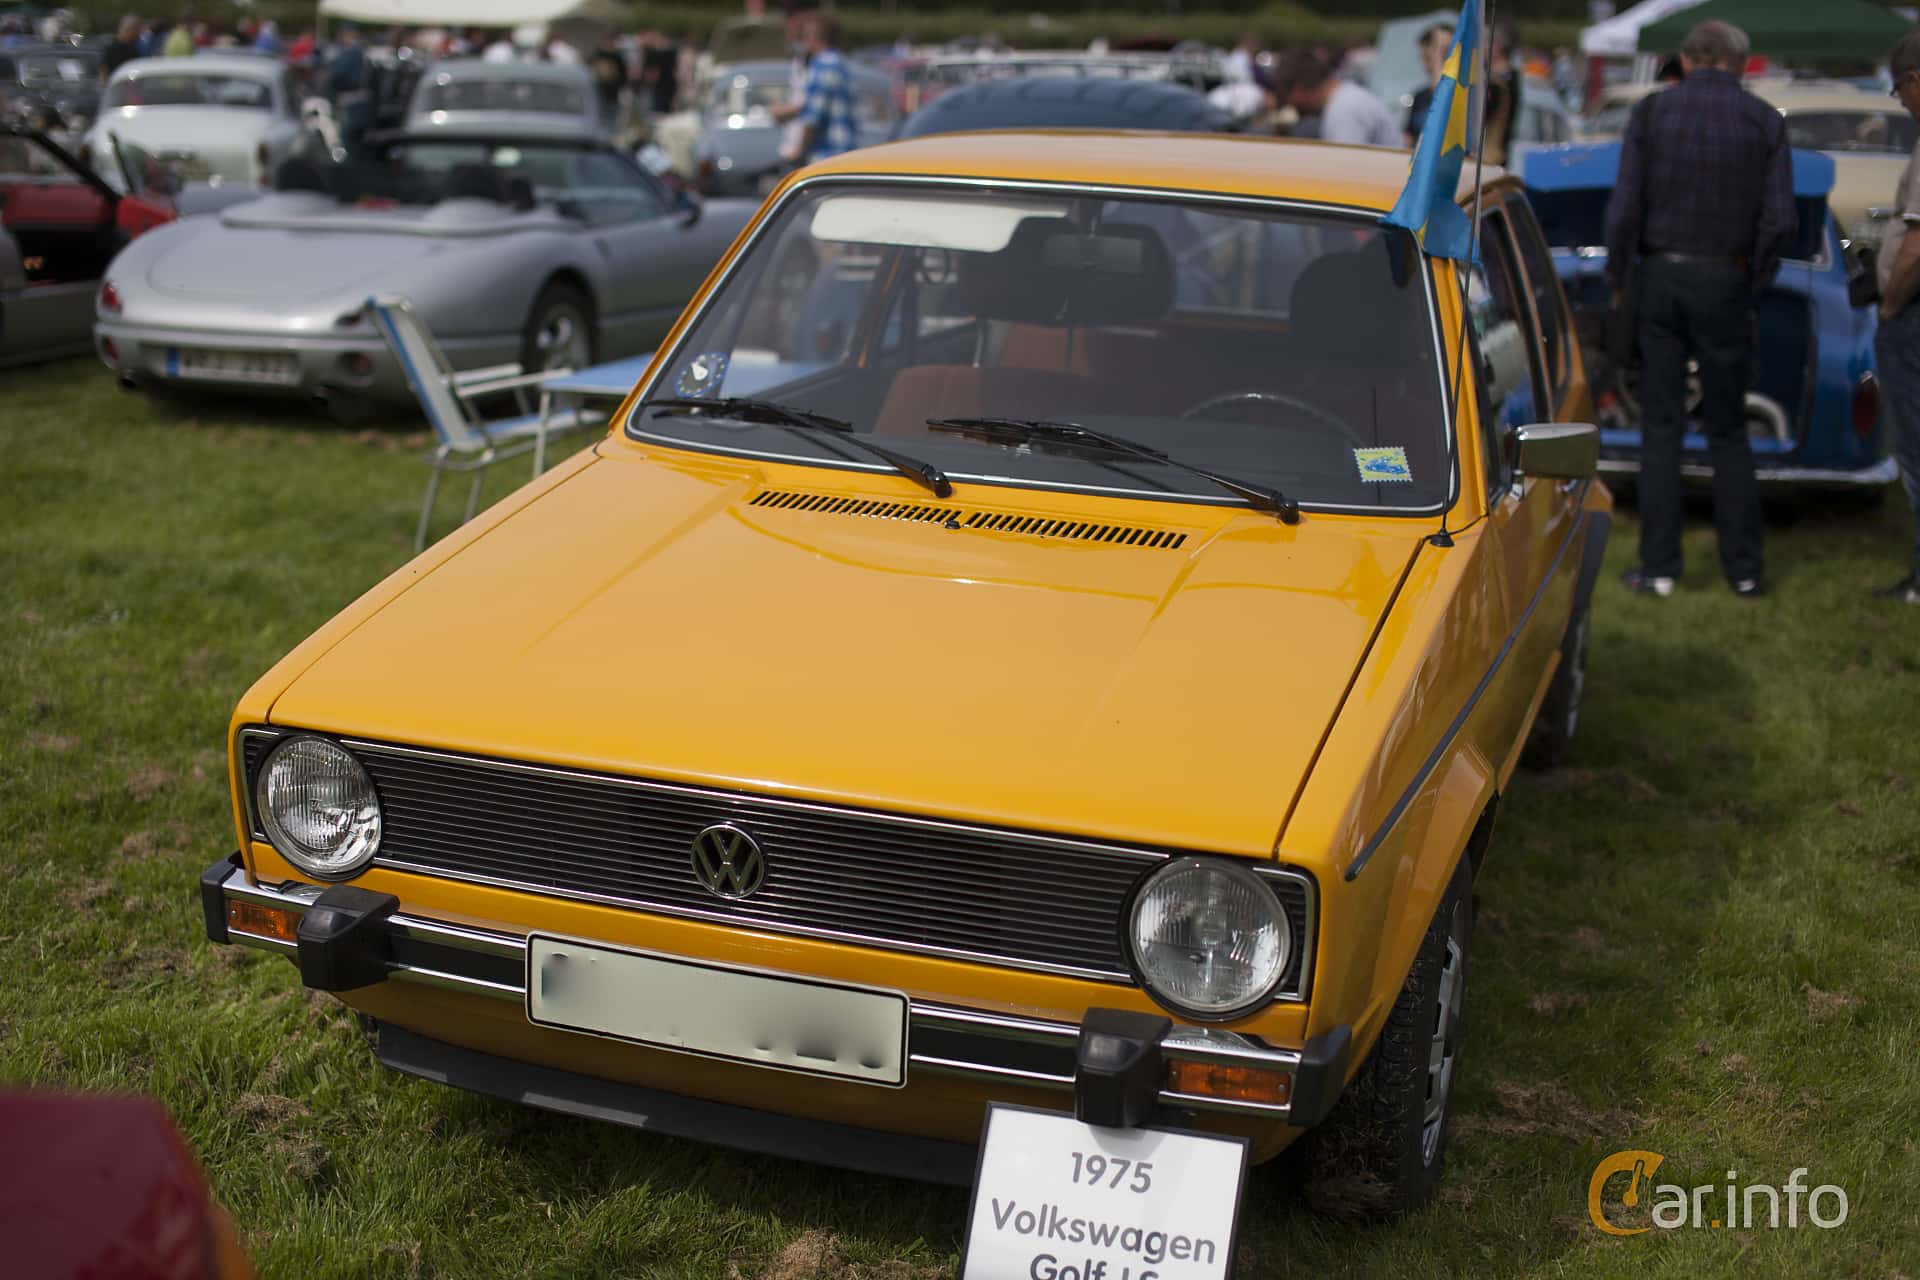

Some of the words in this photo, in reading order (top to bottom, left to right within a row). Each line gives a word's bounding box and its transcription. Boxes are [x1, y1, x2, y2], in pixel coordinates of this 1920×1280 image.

[690, 824, 764, 900] VW
[1071, 1151, 1153, 1194] 1975
[991, 1197, 1216, 1264] Volkswagen
